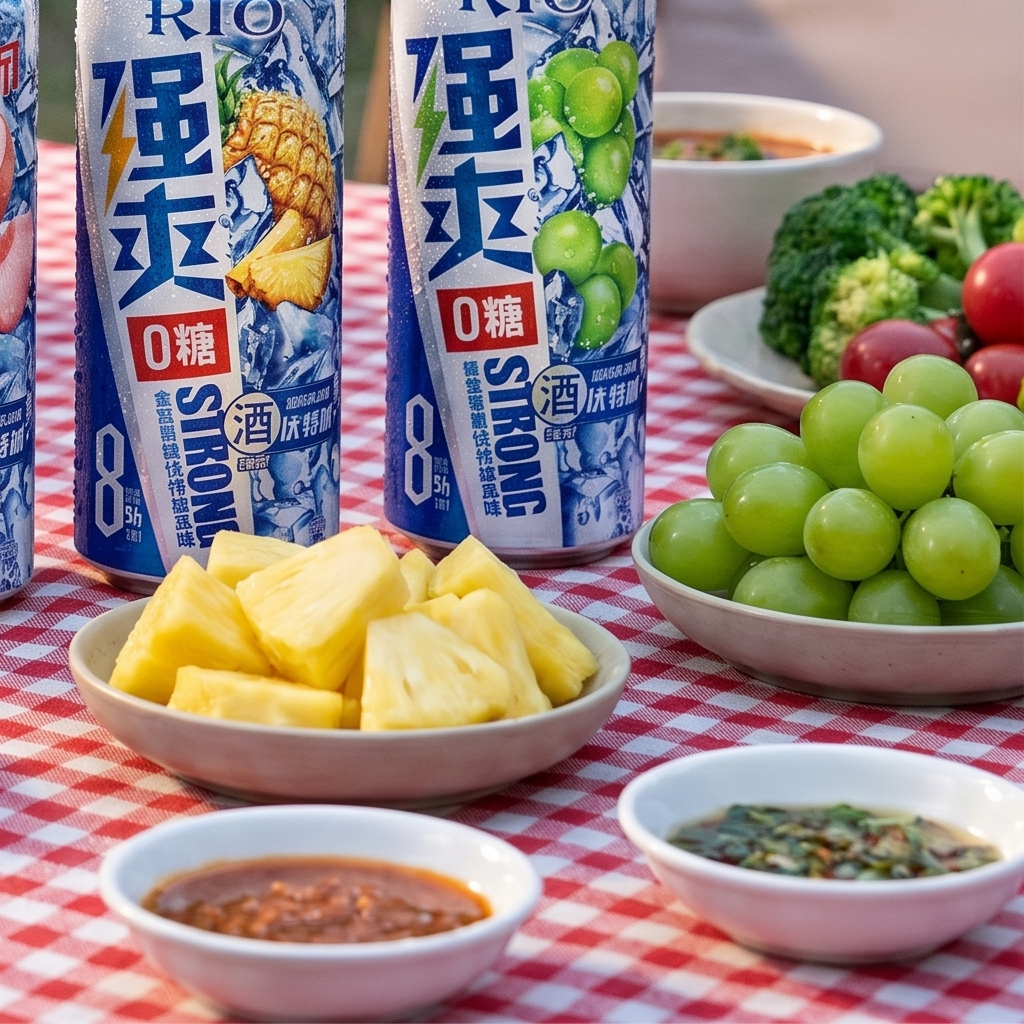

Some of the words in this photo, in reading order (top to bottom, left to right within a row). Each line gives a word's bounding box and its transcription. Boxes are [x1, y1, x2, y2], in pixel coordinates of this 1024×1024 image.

[405, 28, 534, 282] 强爽
[92, 51, 226, 311] 强爽
[452, 295, 524, 342] 0糖
[143, 322, 215, 371] 0糖
[539, 373, 581, 417] 酒
[233, 401, 275, 446] 酒
[483, 354, 547, 518] STRONG
